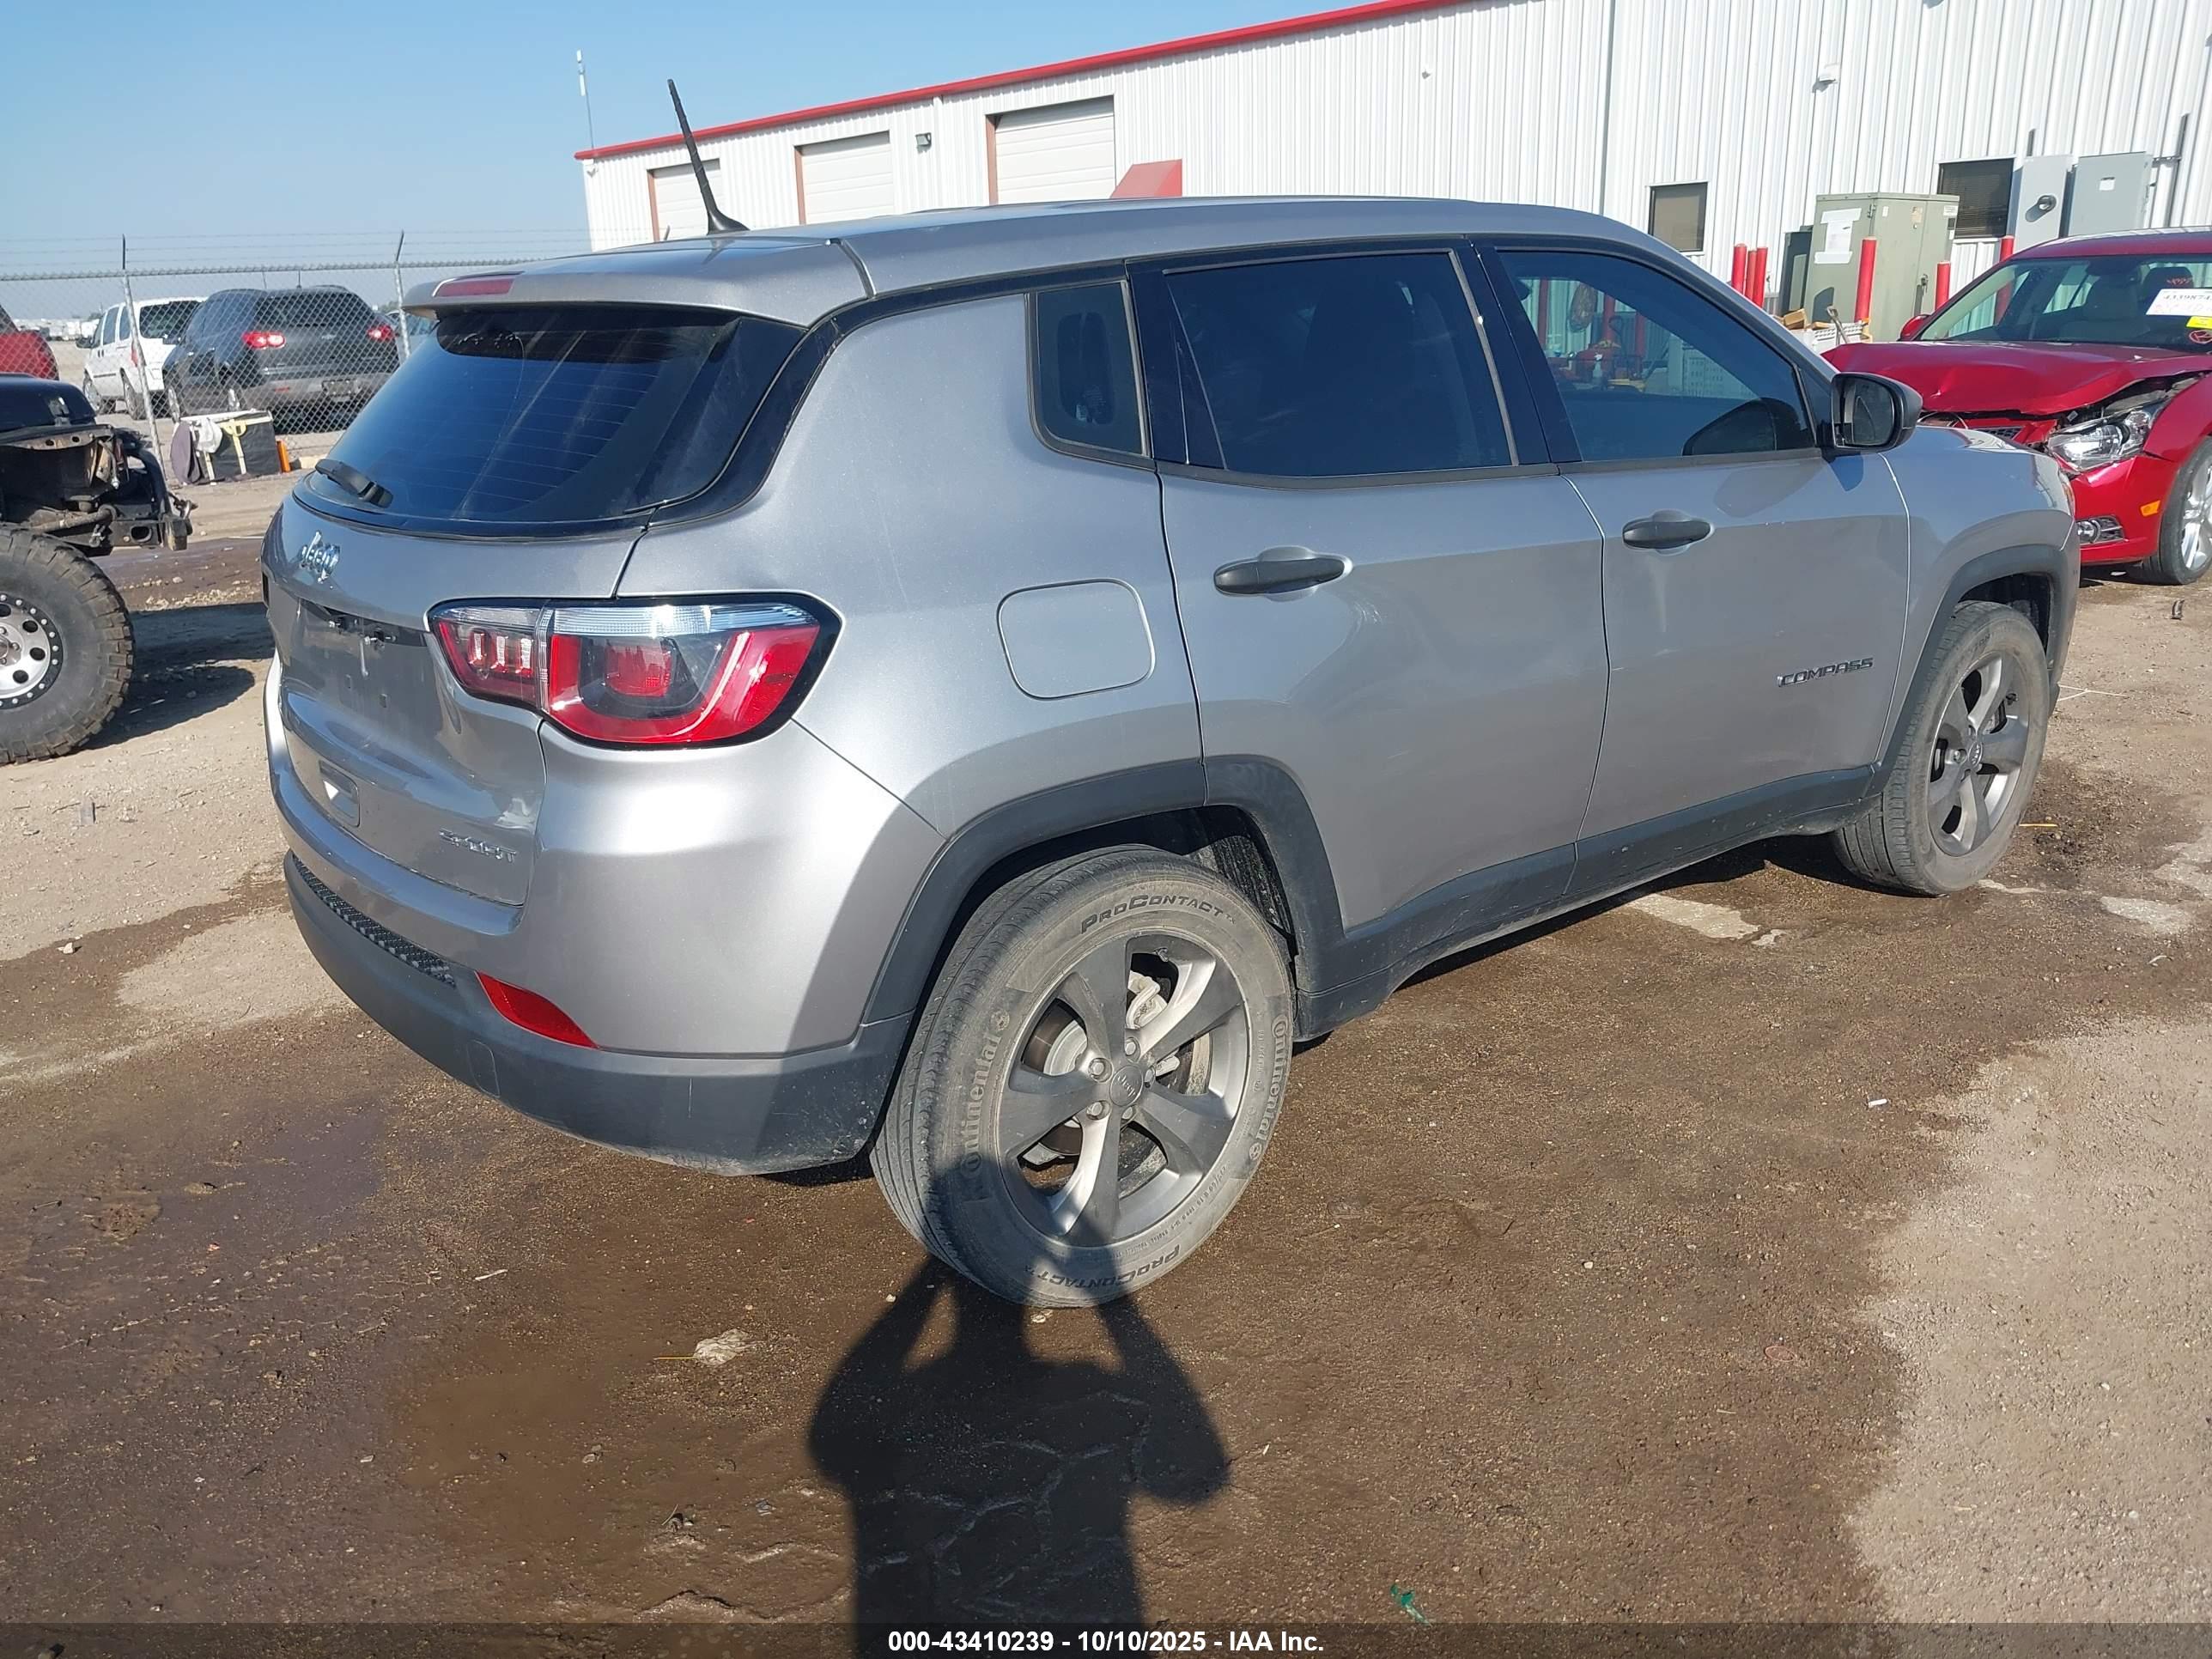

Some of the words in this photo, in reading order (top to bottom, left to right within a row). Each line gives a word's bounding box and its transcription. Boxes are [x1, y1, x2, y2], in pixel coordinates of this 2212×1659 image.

[301, 531, 339, 583] Jeep
[1777, 657, 1875, 687] COMPASS
[440, 827, 517, 863] SPORT
[1256, 1014, 1288, 1140] Continental
[961, 1035, 1002, 1177] Continental
